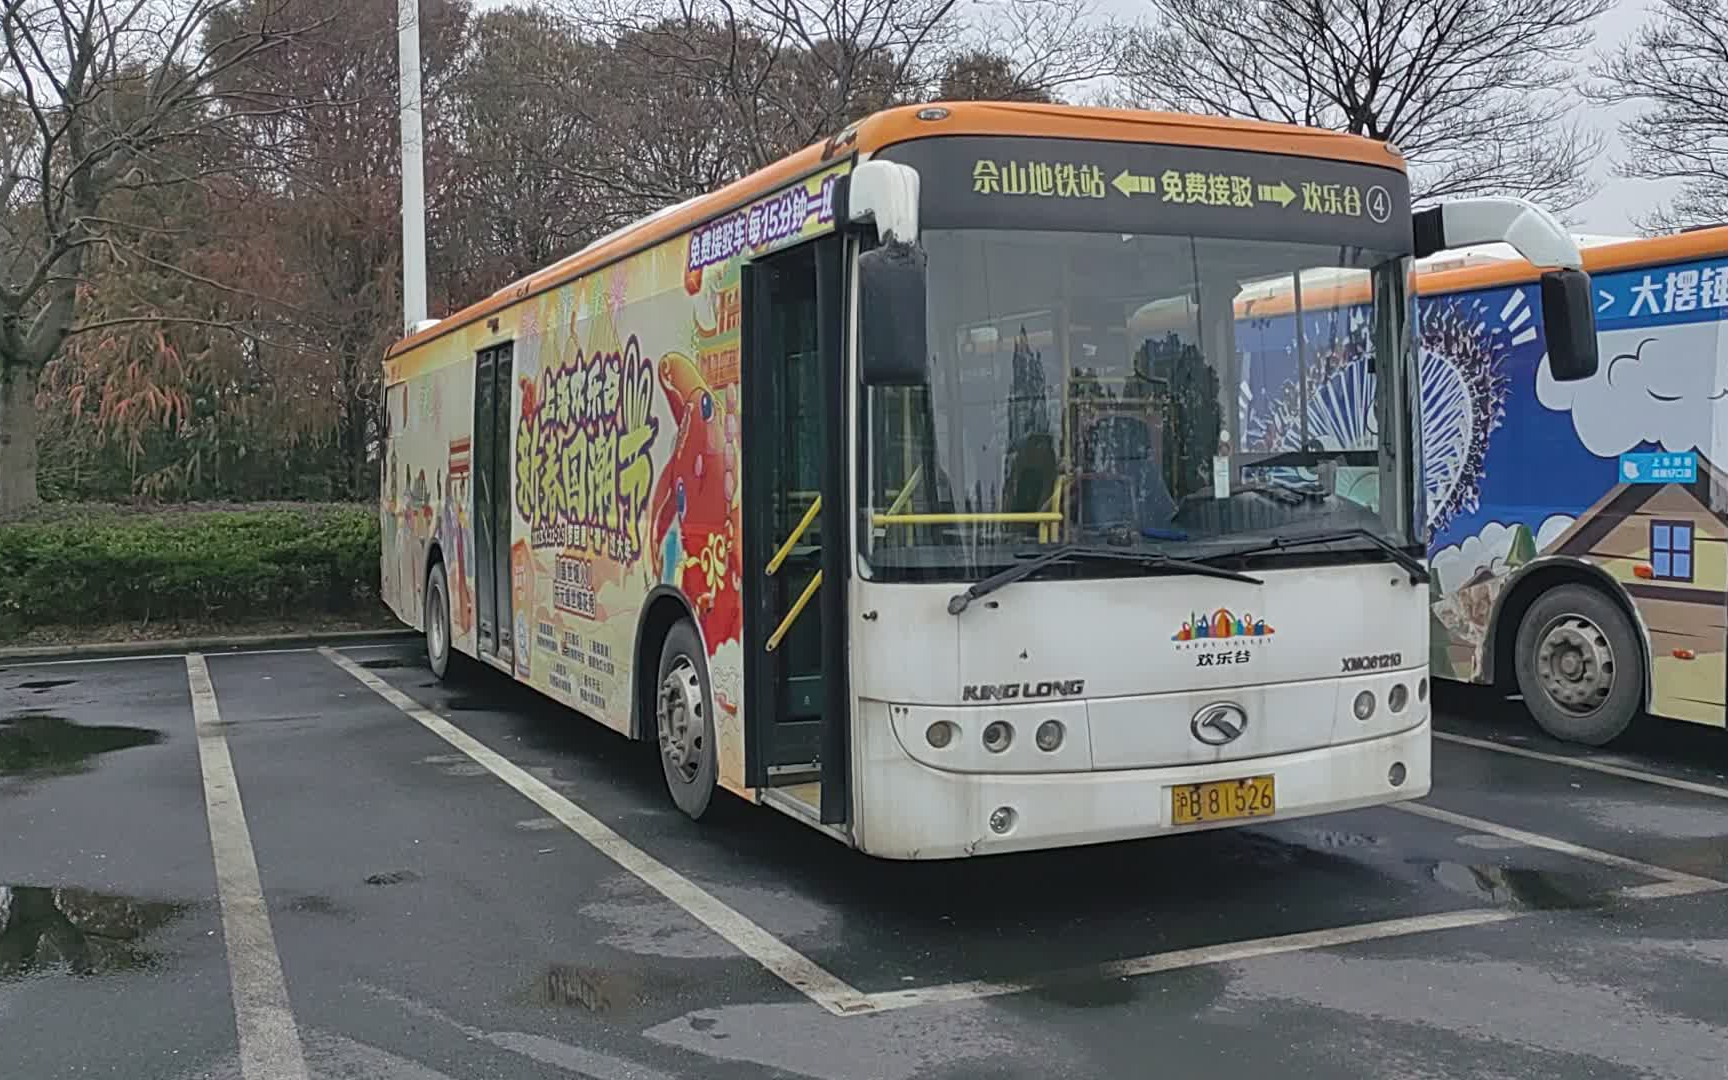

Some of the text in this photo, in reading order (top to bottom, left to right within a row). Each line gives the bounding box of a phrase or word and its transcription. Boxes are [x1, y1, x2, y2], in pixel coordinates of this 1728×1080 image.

[972, 159, 1106, 198] 佘山地铁站
[1160, 169, 1253, 208] 免费接驳
[1300, 181, 1362, 216] 欢乐谷
[1629, 266, 1728, 316] 大摆锤
[1196, 650, 1251, 667] 欢乐谷
[963, 680, 1085, 701] KING LONG
